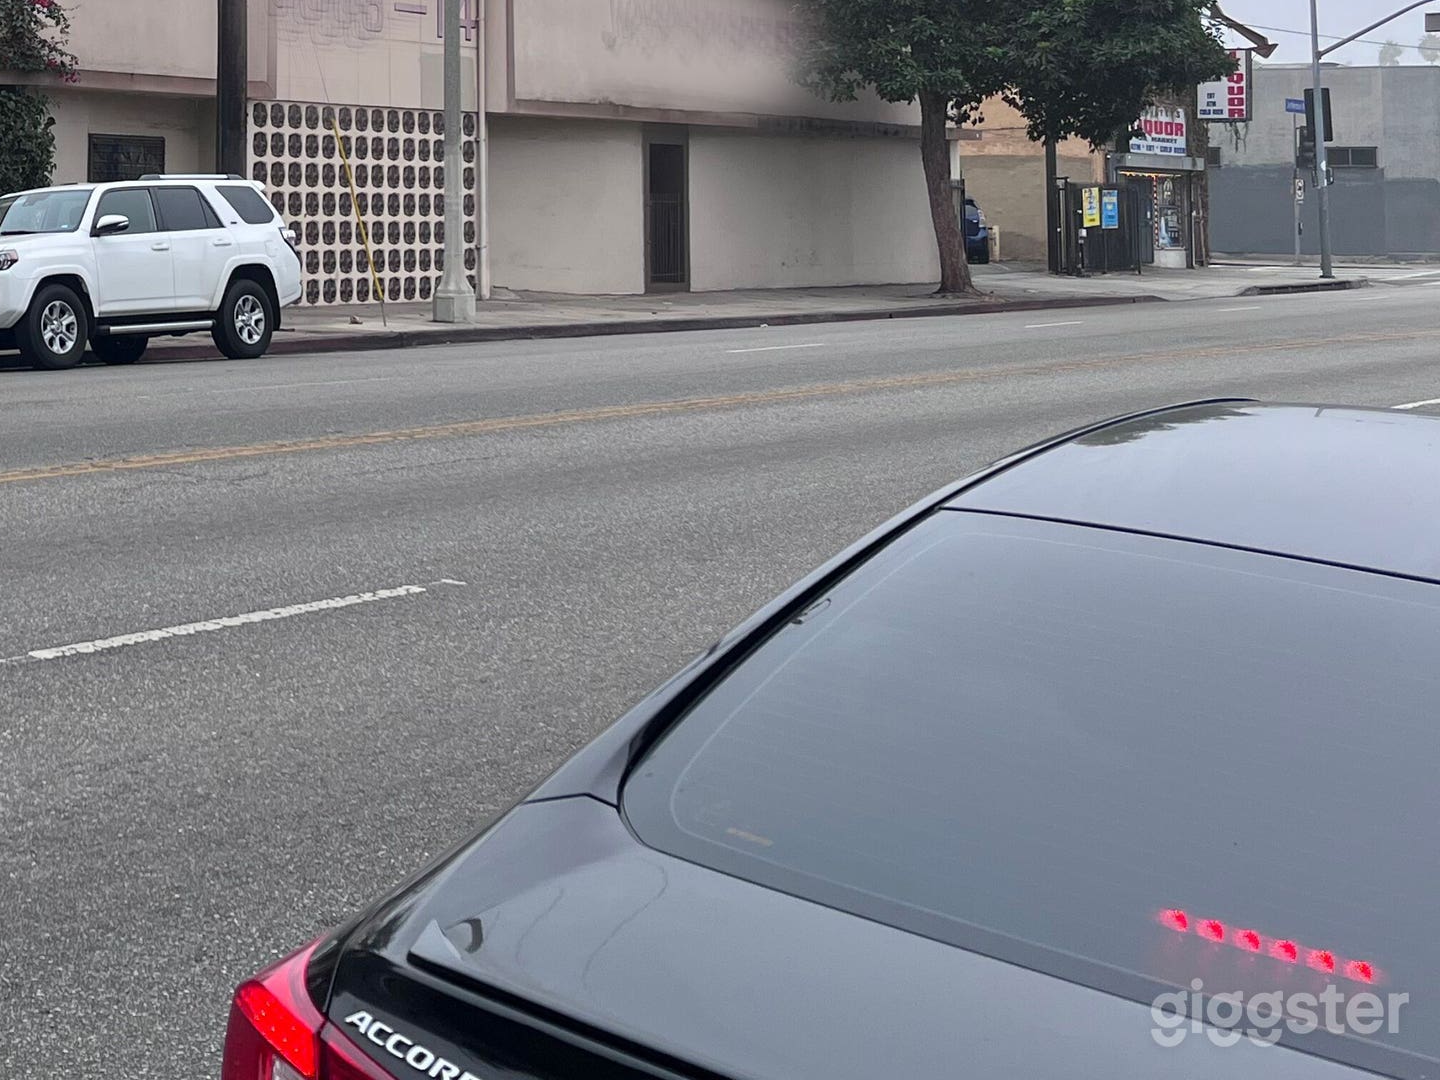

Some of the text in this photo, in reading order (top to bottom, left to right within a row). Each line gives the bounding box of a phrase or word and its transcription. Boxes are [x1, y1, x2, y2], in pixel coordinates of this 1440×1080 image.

[1227, 50, 1245, 118] QUOR
[1138, 119, 1184, 137] QUOR
[344, 1010, 482, 1080] ACCOR
